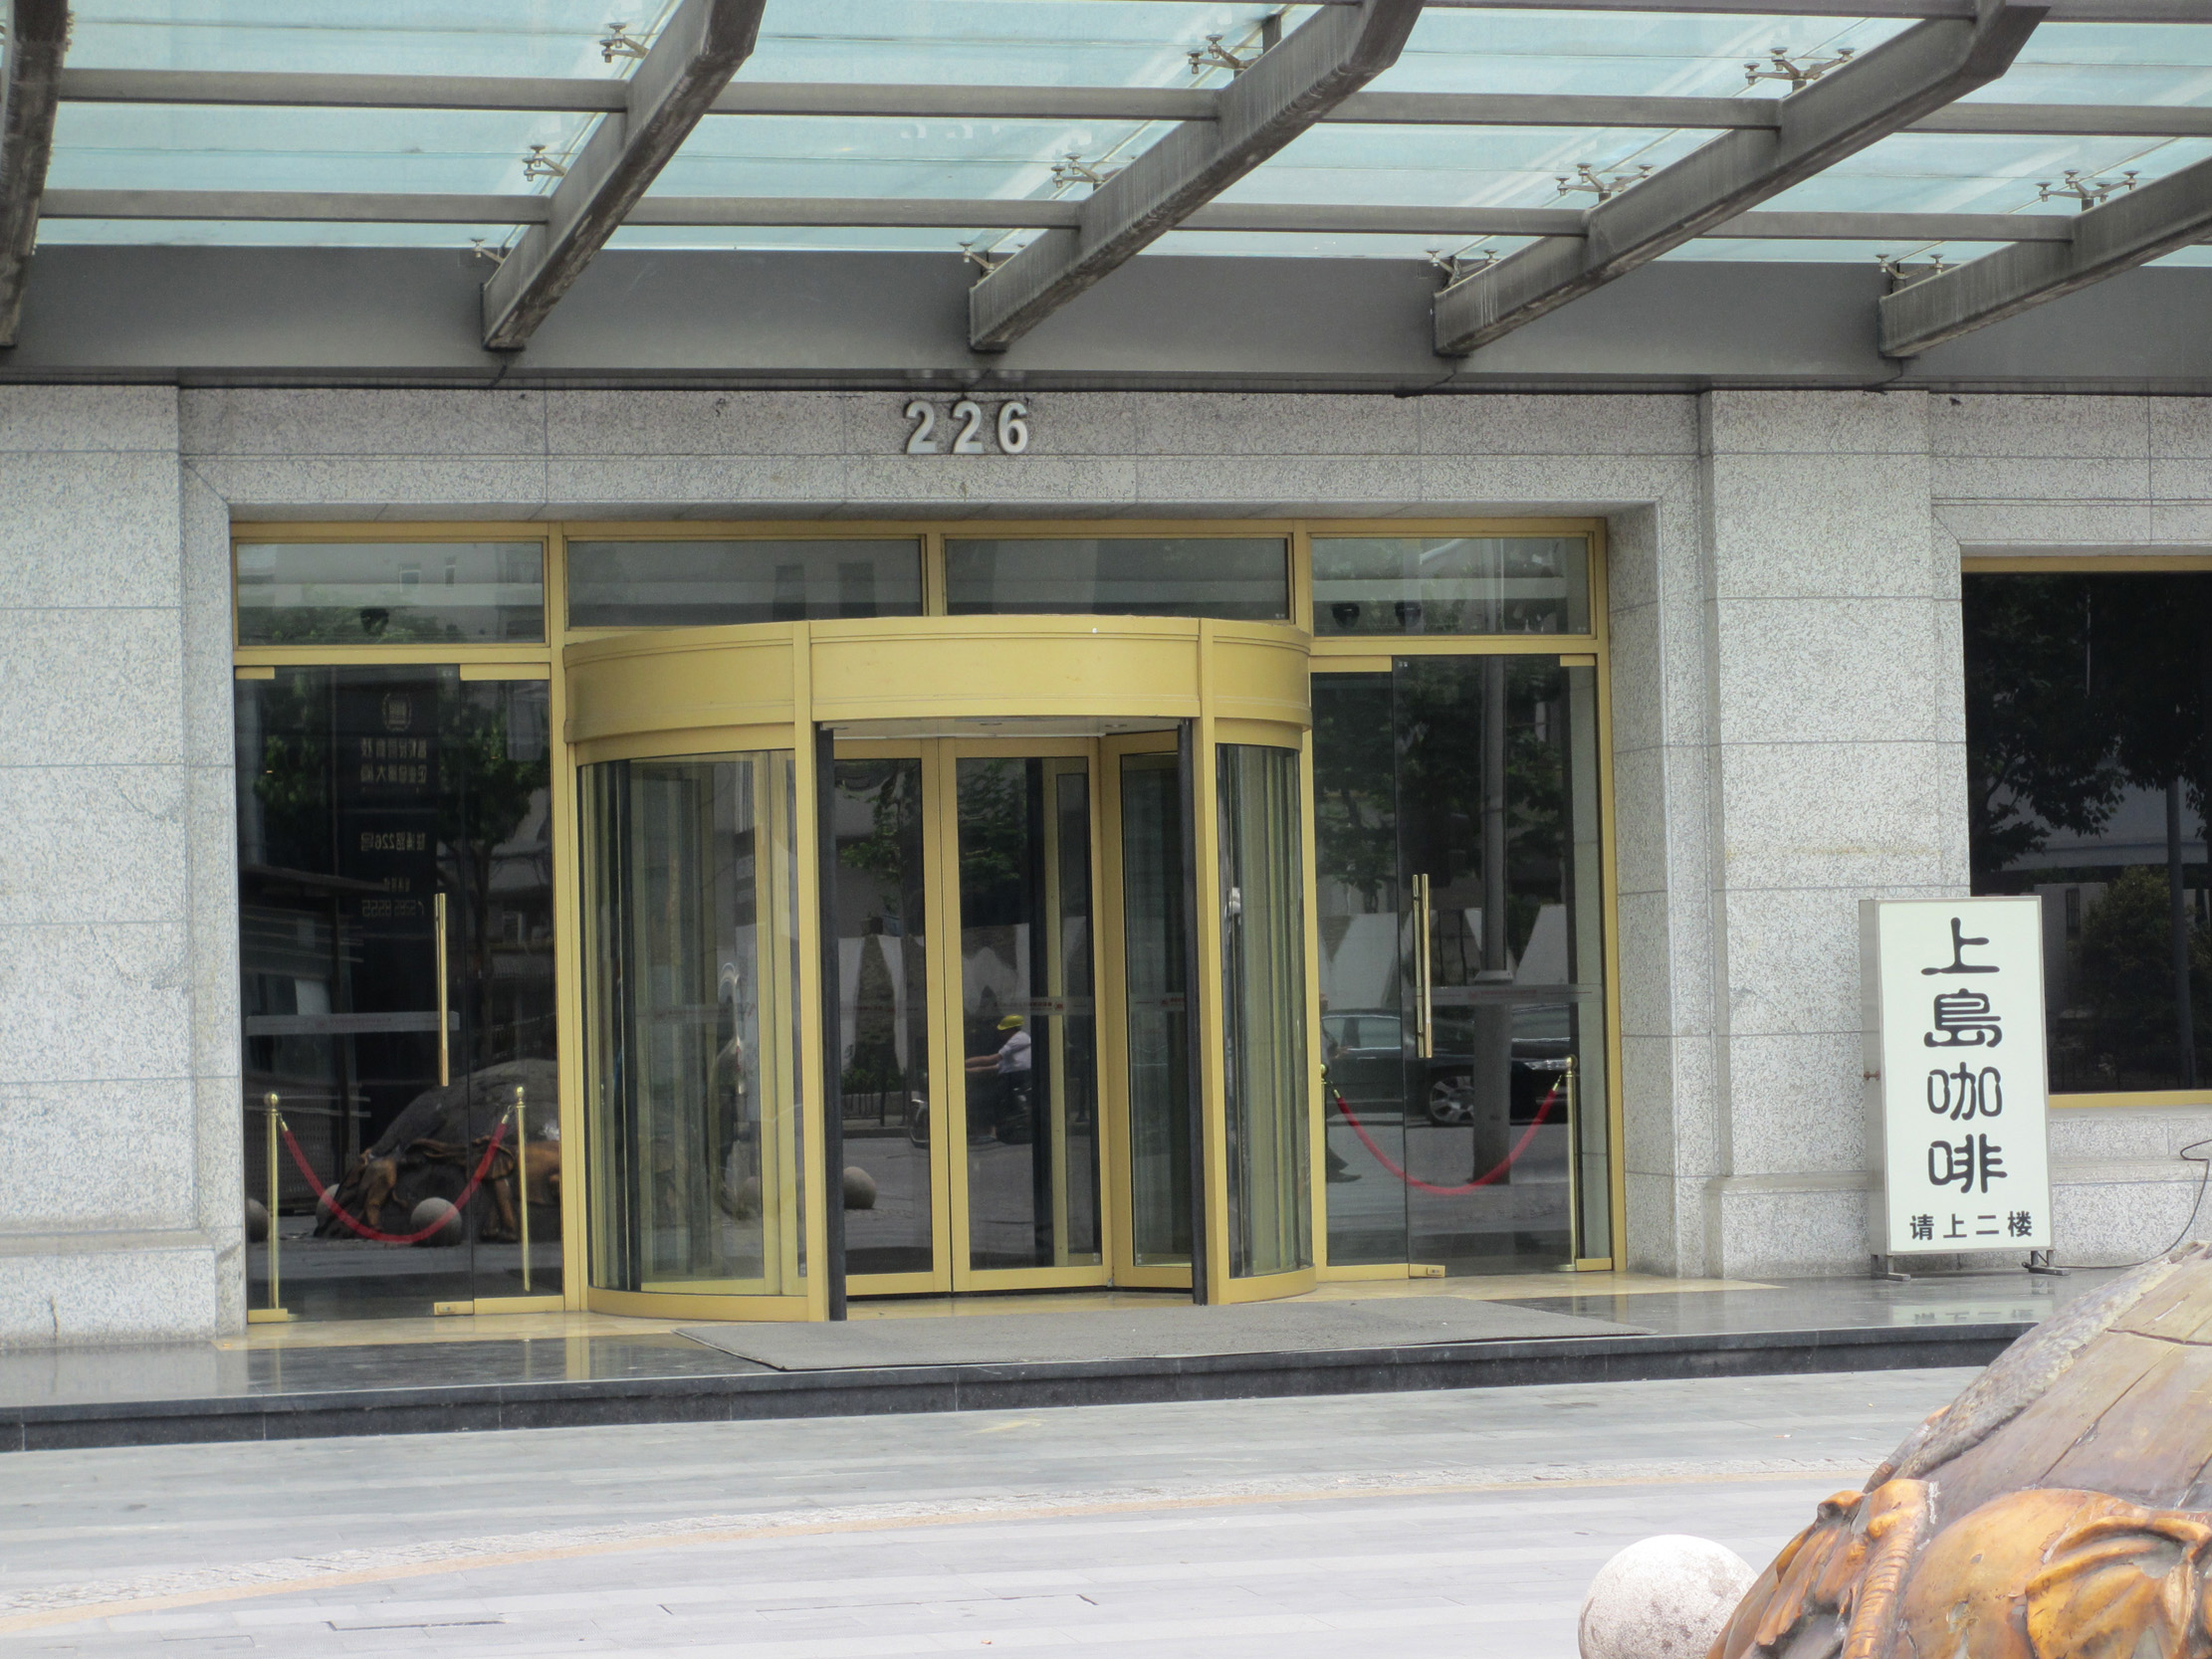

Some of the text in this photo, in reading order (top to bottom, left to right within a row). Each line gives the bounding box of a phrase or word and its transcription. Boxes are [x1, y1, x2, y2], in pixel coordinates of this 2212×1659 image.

[905, 400, 1028, 455] 226
[1920, 917, 2008, 1194] 上島咖啡
[1909, 1210, 2033, 1241] 请上二楼
